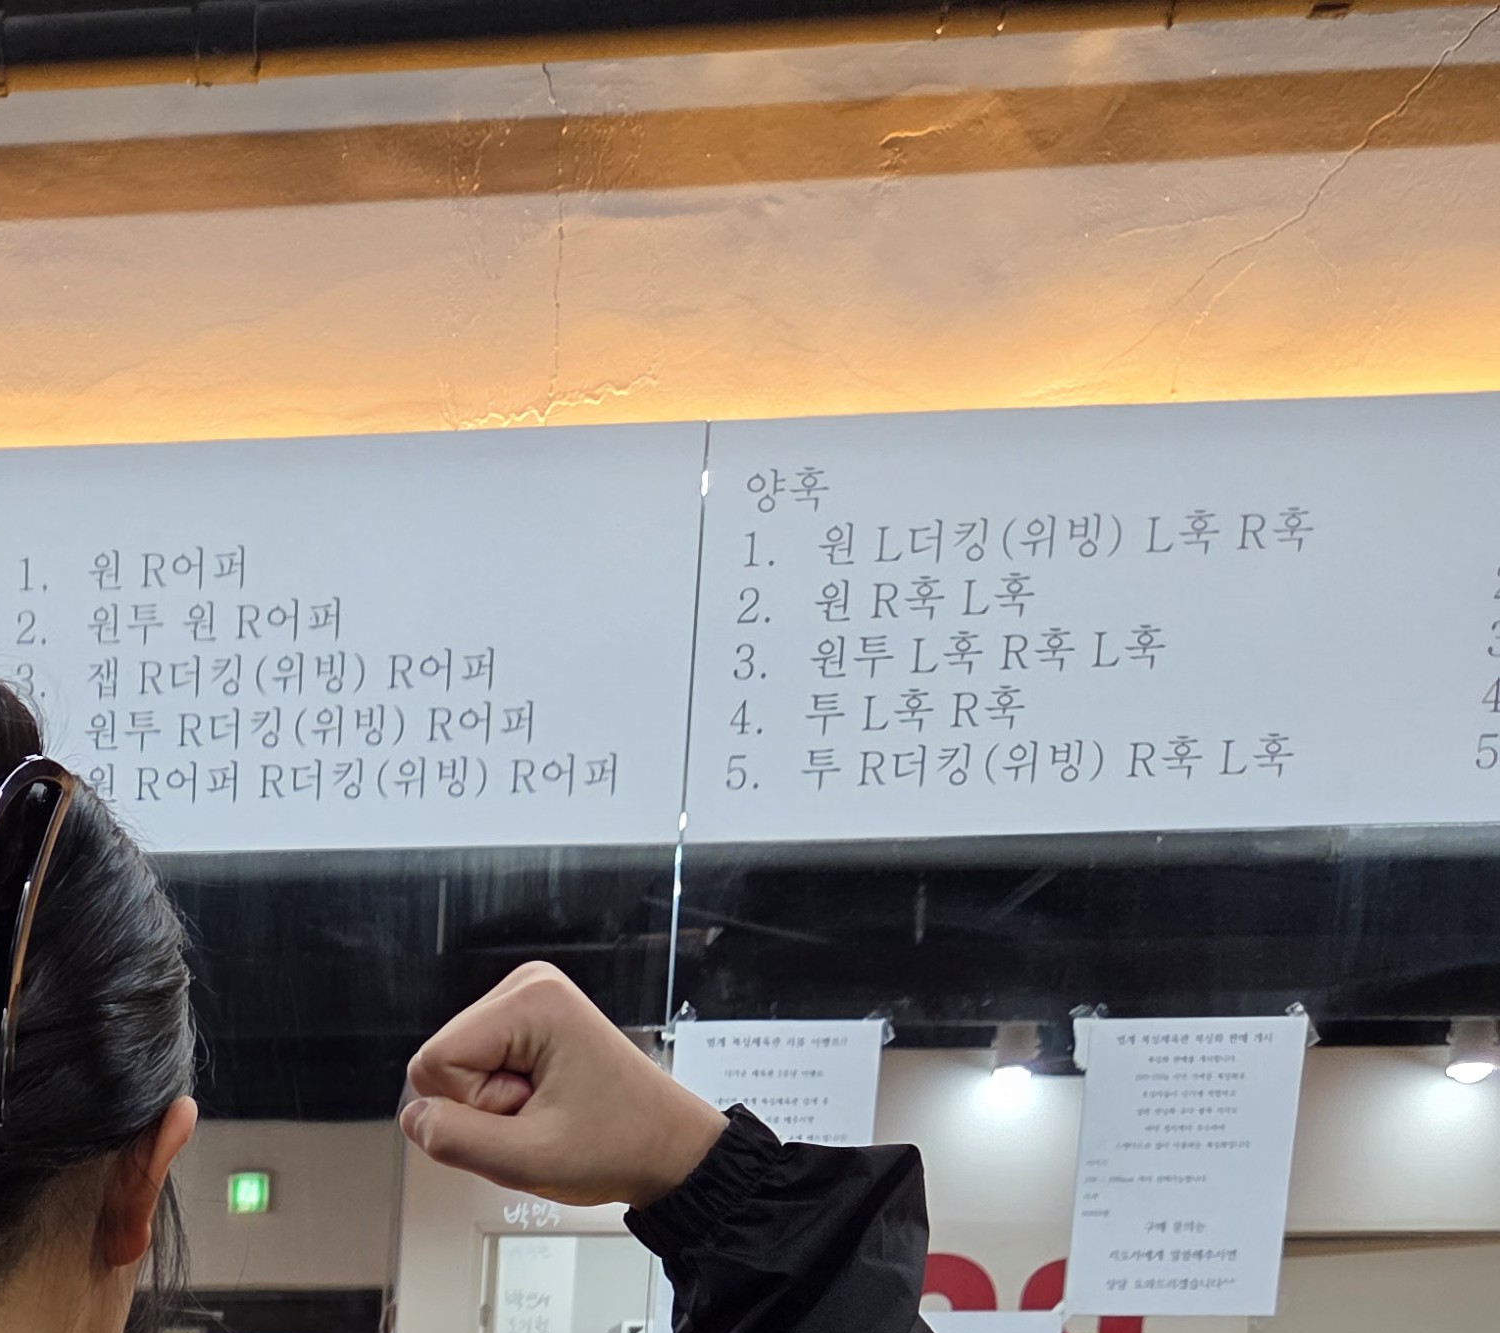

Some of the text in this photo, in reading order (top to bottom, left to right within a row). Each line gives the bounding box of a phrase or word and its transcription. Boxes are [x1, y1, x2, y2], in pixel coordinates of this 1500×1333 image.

[746, 466, 831, 514] 양훅
[743, 506, 1315, 568] 1. 원 L더킹(위빙) L훅 R훅
[19, 544, 245, 593] 1. 원 R어퍼
[15, 595, 341, 648] 2. 원투 원 R어퍼
[736, 571, 1036, 625] 2. 원 R훅 L훅
[87, 655, 119, 702] 잽
[137, 649, 366, 700] R더킹(위빙)
[387, 645, 495, 694] R어퍼
[732, 623, 1167, 681] 3. 원투 L훅 R훅 L훅
[84, 699, 535, 755] 원투 R더킹(위빙) R어퍼
[729, 684, 1026, 737] 4. 투 L훅 R훅
[134, 759, 239, 805] R어퍼
[258, 754, 488, 802] R더킹(위빙)
[510, 751, 618, 798] R어퍼
[725, 732, 1295, 792] 5. 투 R더킹(위빙) R훅 L훅
